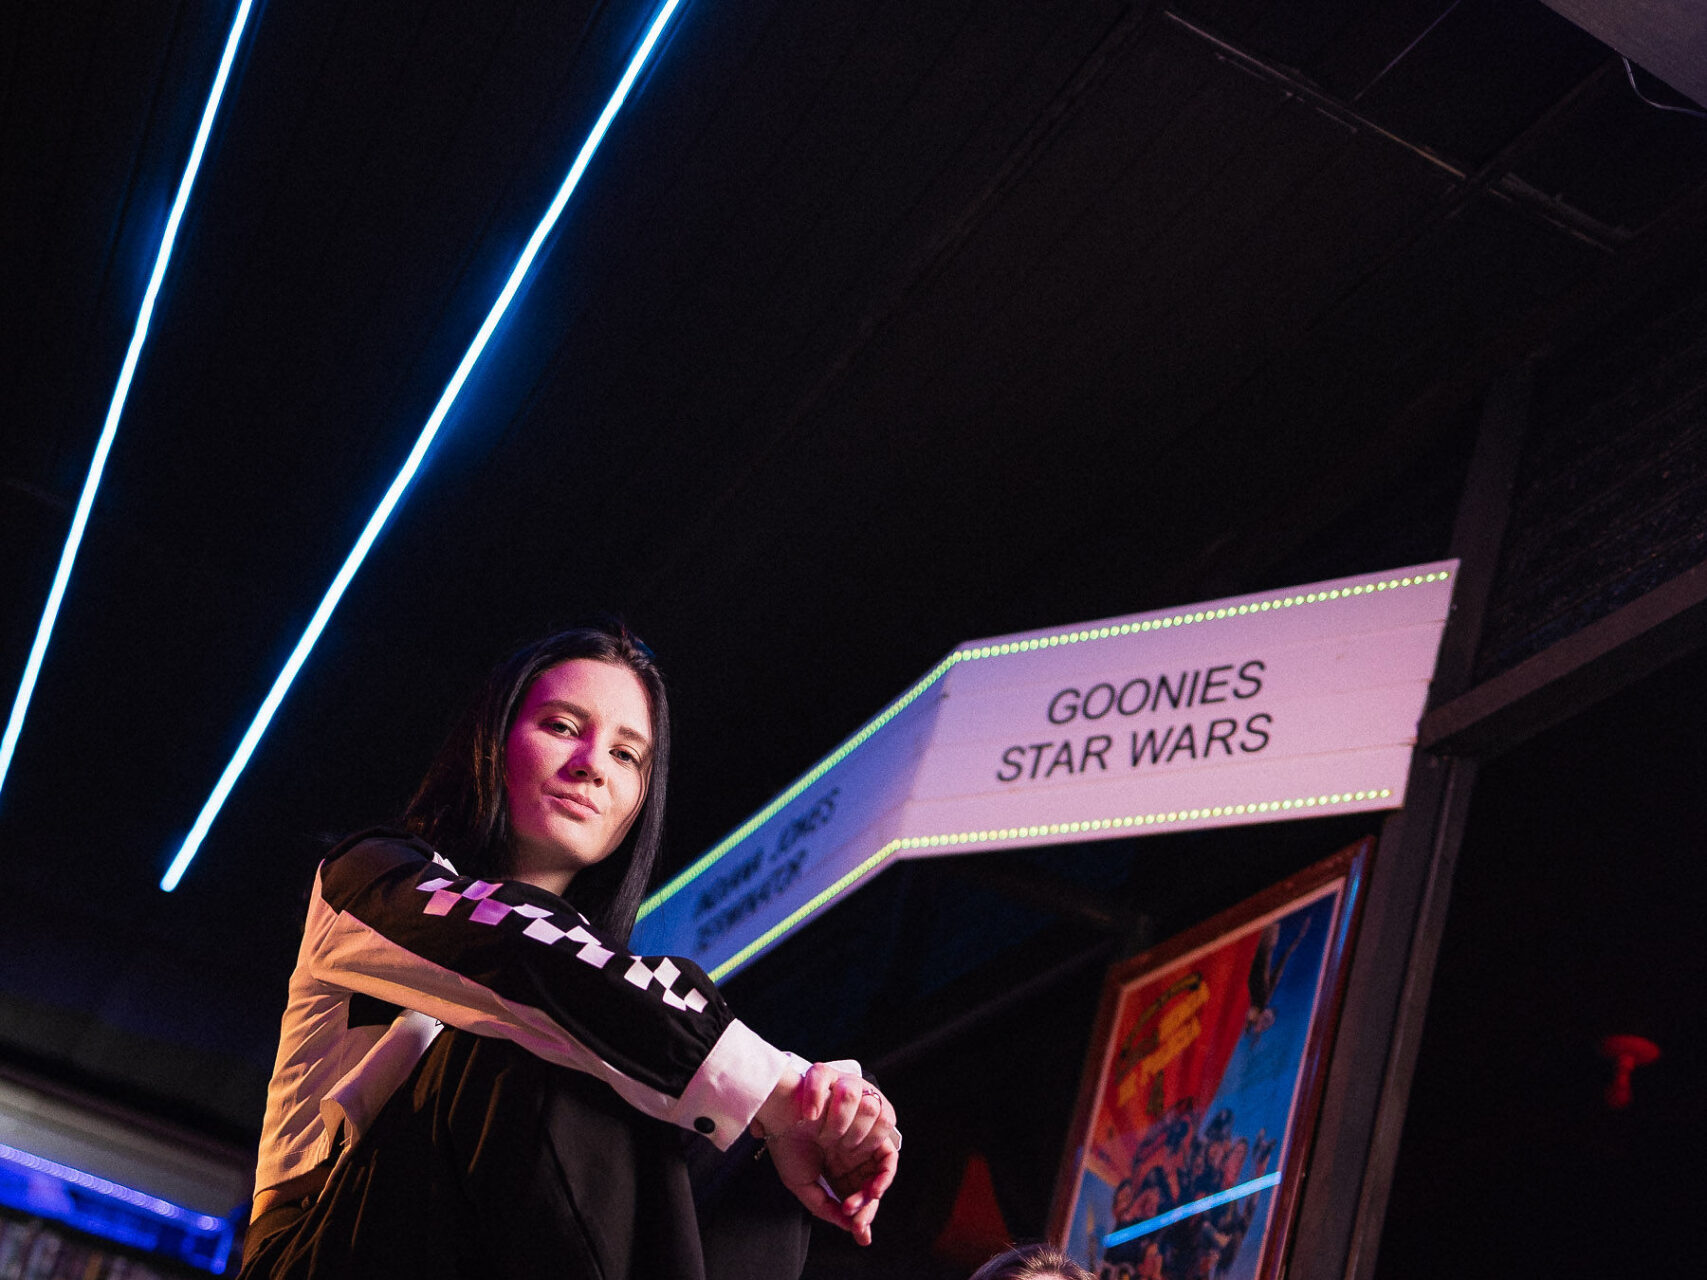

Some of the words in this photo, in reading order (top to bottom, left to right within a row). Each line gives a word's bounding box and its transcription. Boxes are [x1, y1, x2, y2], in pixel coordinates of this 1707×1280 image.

[1047, 660, 1266, 725] GOONIES
[997, 734, 1113, 782] STAR
[1130, 713, 1273, 768] WARS
